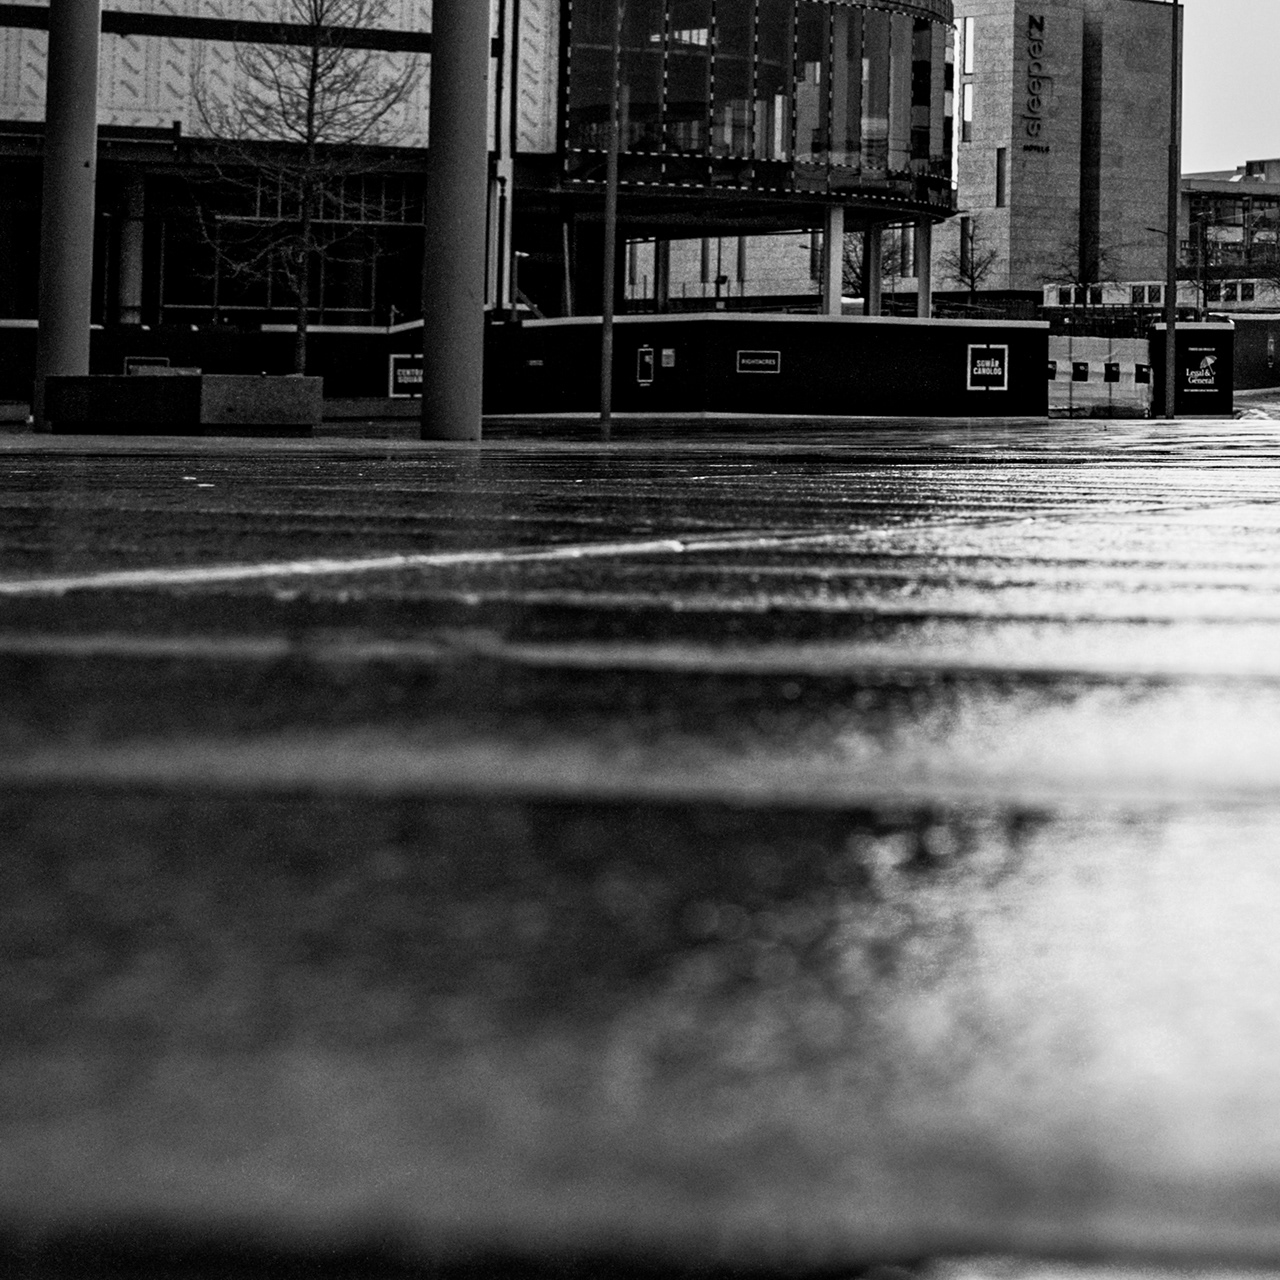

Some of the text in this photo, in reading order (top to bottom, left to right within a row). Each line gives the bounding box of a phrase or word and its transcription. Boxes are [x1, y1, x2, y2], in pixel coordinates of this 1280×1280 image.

[1021, 14, 1052, 138] sleeperz
[1186, 368, 1204, 379] Legal
[1188, 376, 1215, 384] General
